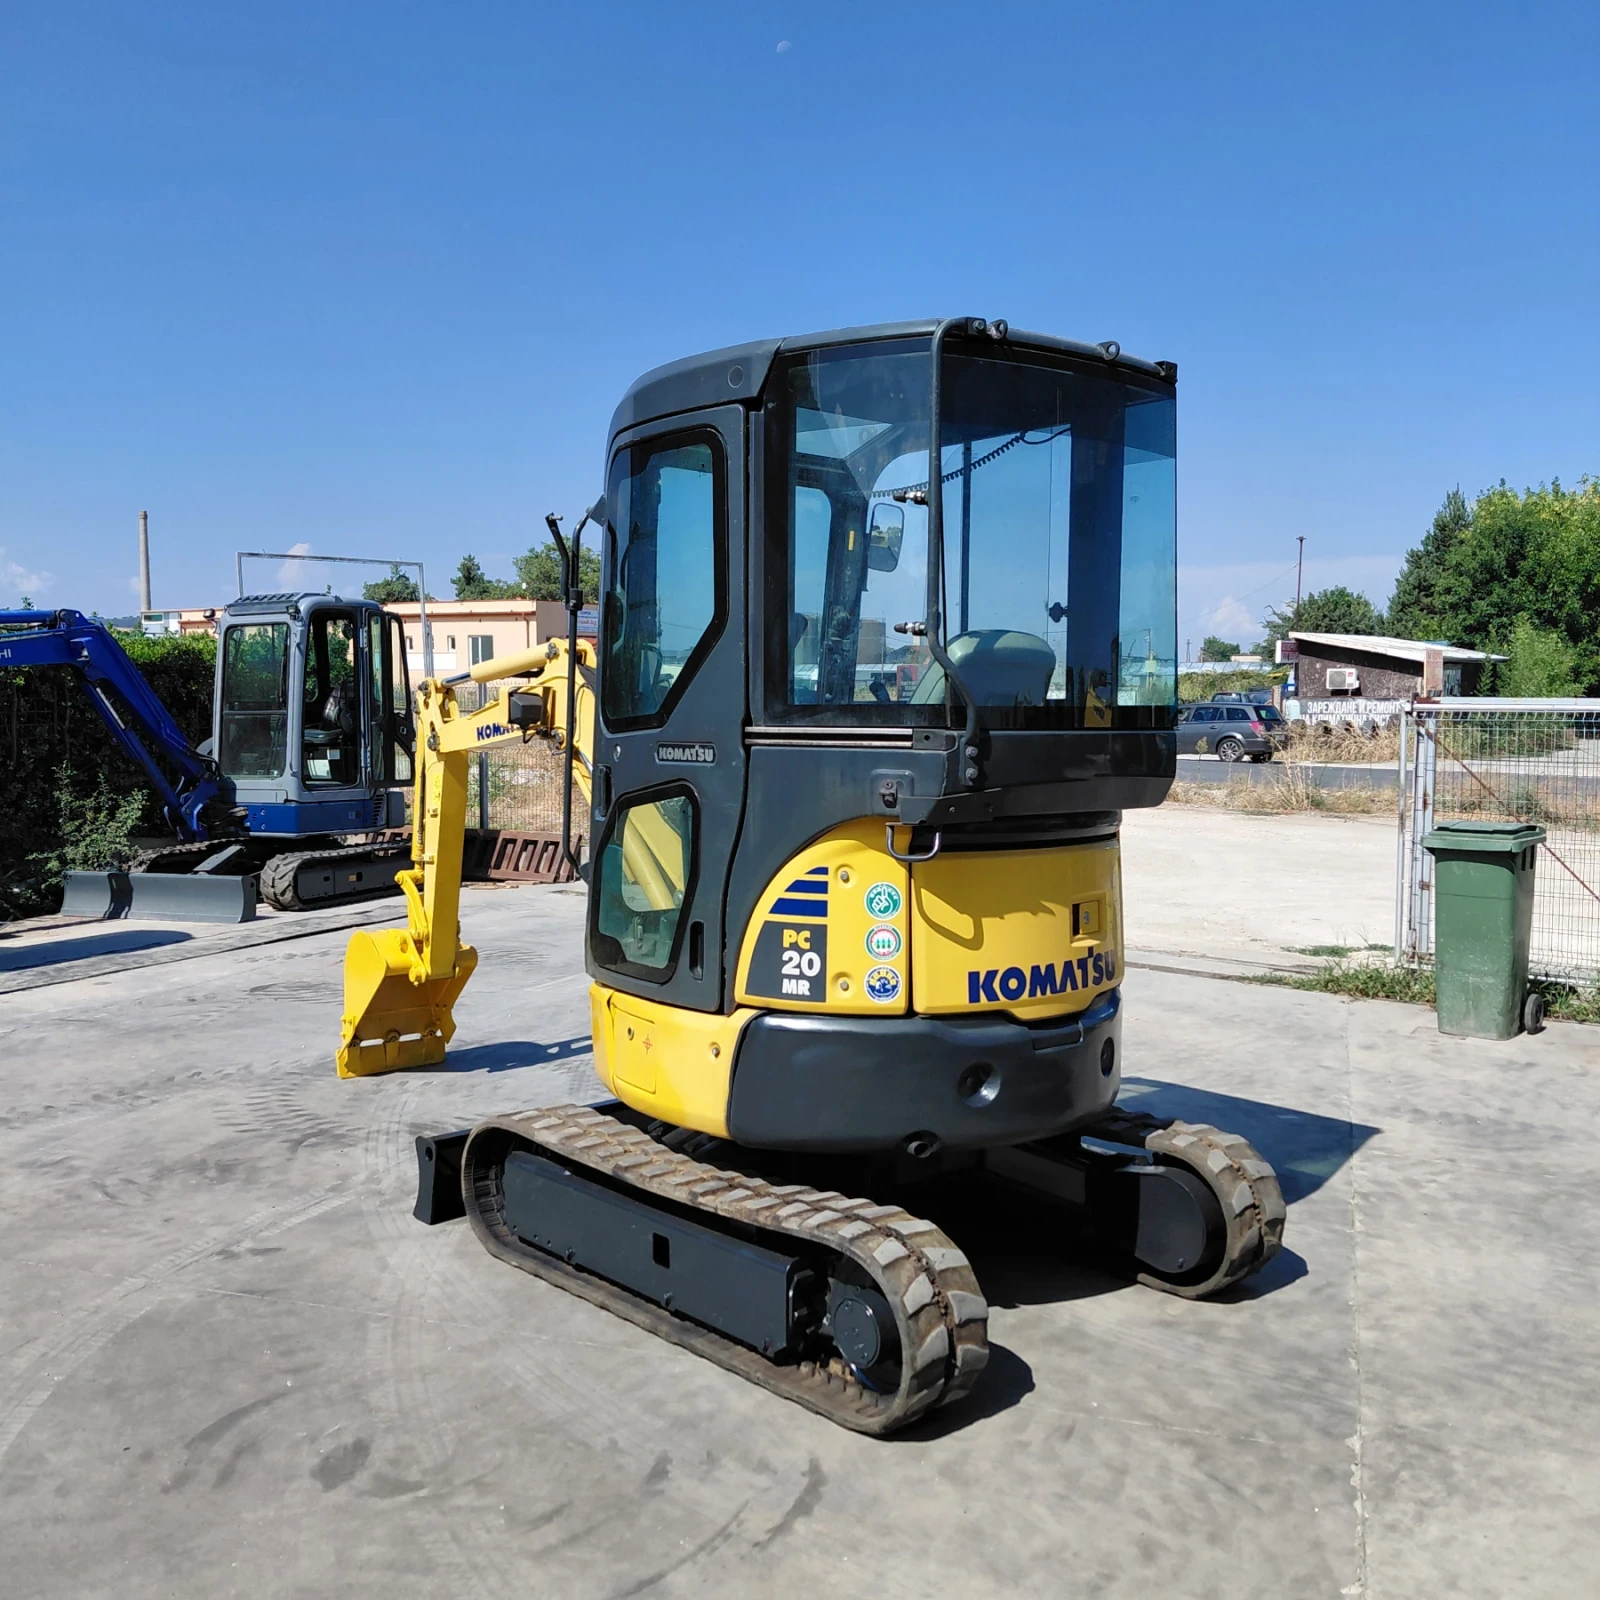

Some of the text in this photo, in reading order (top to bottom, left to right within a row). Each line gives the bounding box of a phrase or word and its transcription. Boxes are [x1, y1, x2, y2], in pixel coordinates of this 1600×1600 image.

[1307, 701, 1357, 714] ЗАРЕЖДАНЕ
[1367, 701, 1400, 714] РЕМОНТ
[658, 745, 714, 762] KOMATSU
[783, 929, 811, 950] PC
[781, 950, 822, 977] 20
[968, 946, 1116, 1004] KOMATSU
[782, 978, 811, 996] MR
